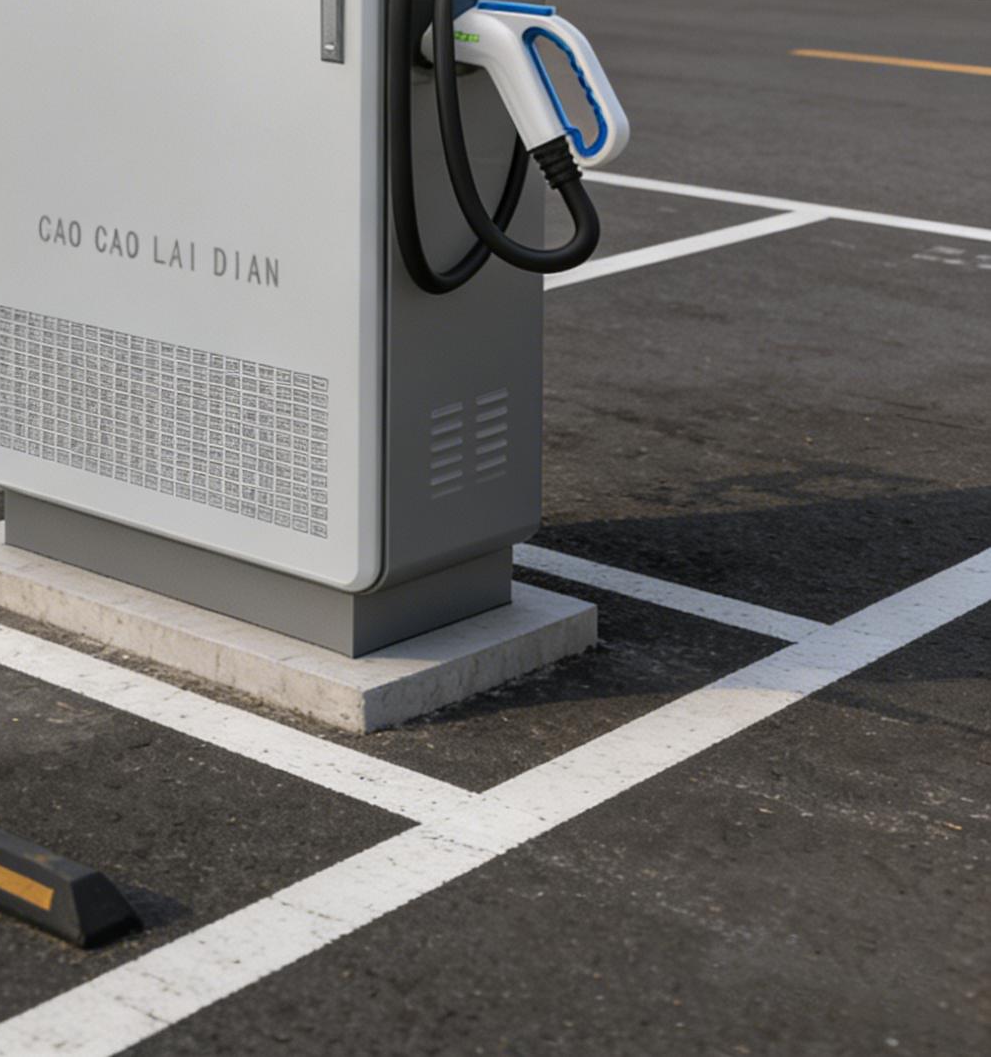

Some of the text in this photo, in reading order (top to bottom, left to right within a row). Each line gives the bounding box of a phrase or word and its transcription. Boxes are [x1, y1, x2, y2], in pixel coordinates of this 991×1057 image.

[39, 215, 279, 288] CAO CAO LAI DIAN
